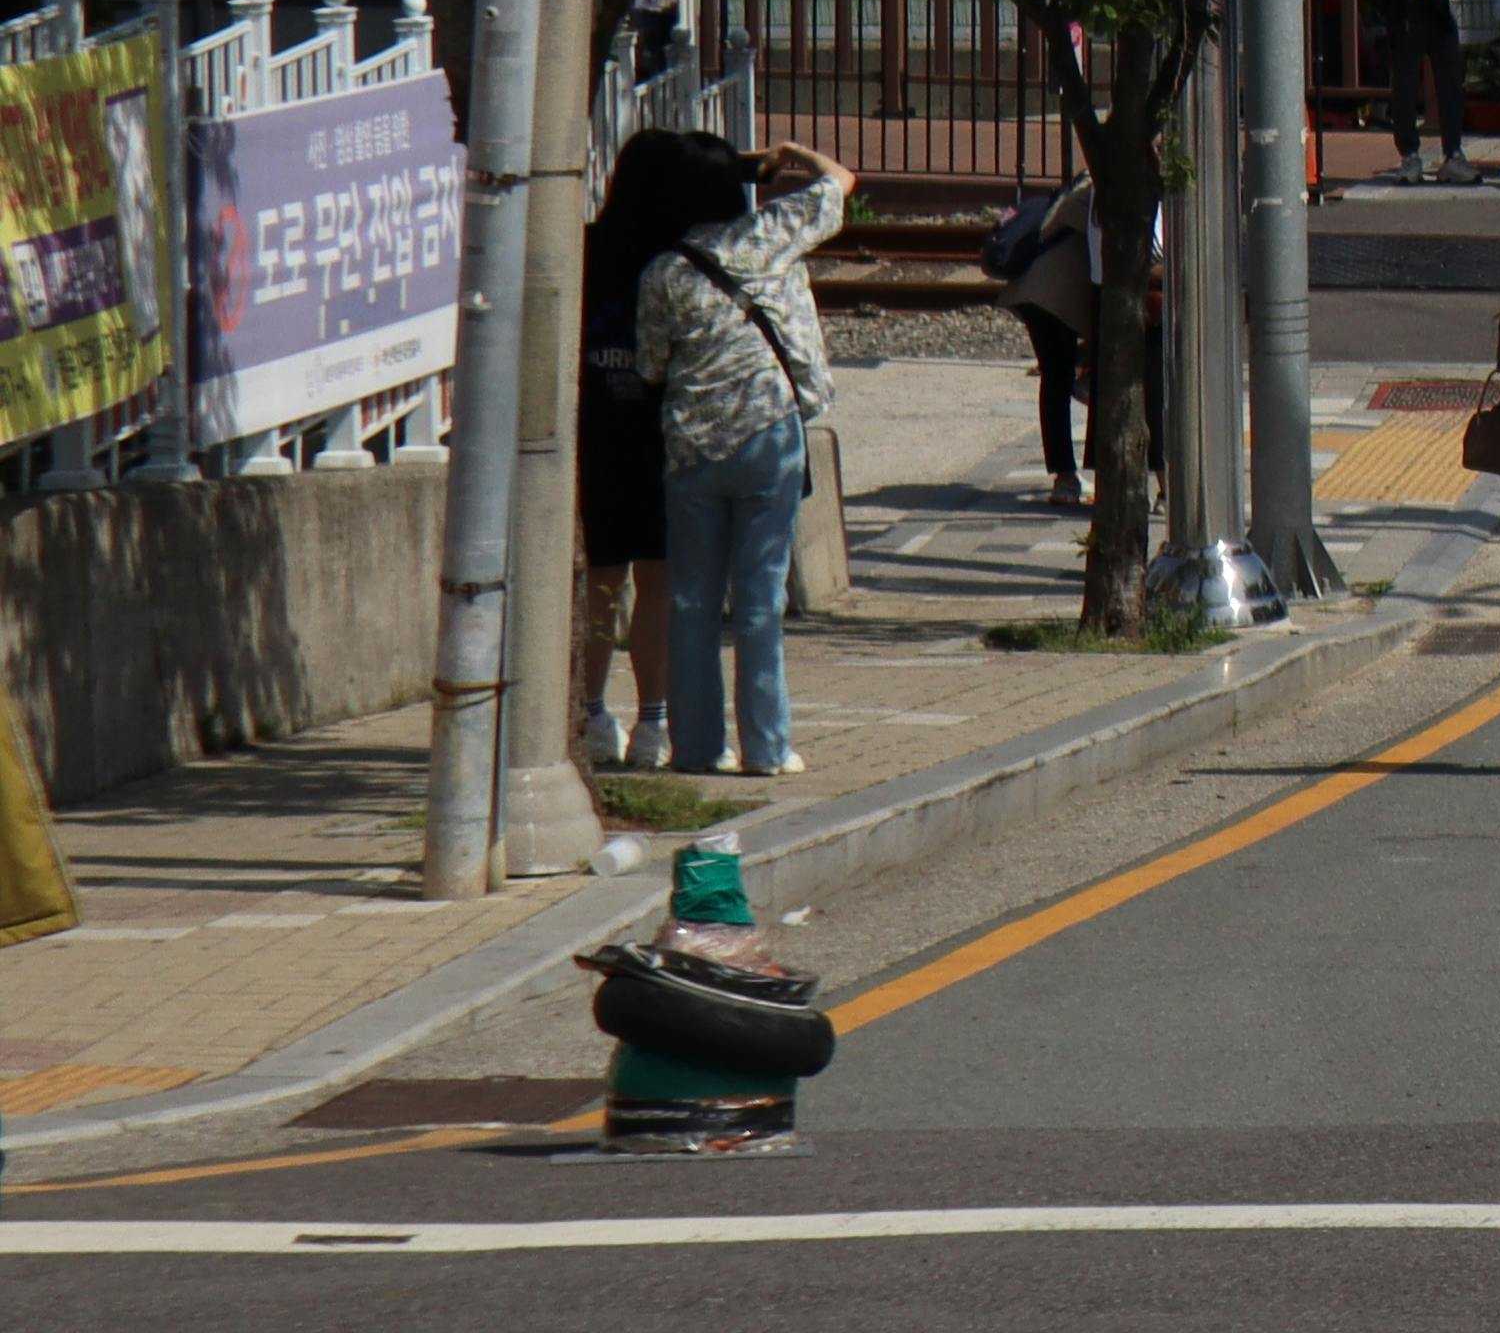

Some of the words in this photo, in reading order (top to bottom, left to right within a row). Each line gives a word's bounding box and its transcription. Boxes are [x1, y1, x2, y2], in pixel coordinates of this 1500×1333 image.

[254, 199, 308, 305] 도로
[314, 181, 364, 301] 무단
[367, 167, 414, 284] 진입
[418, 154, 463, 269] 금지
